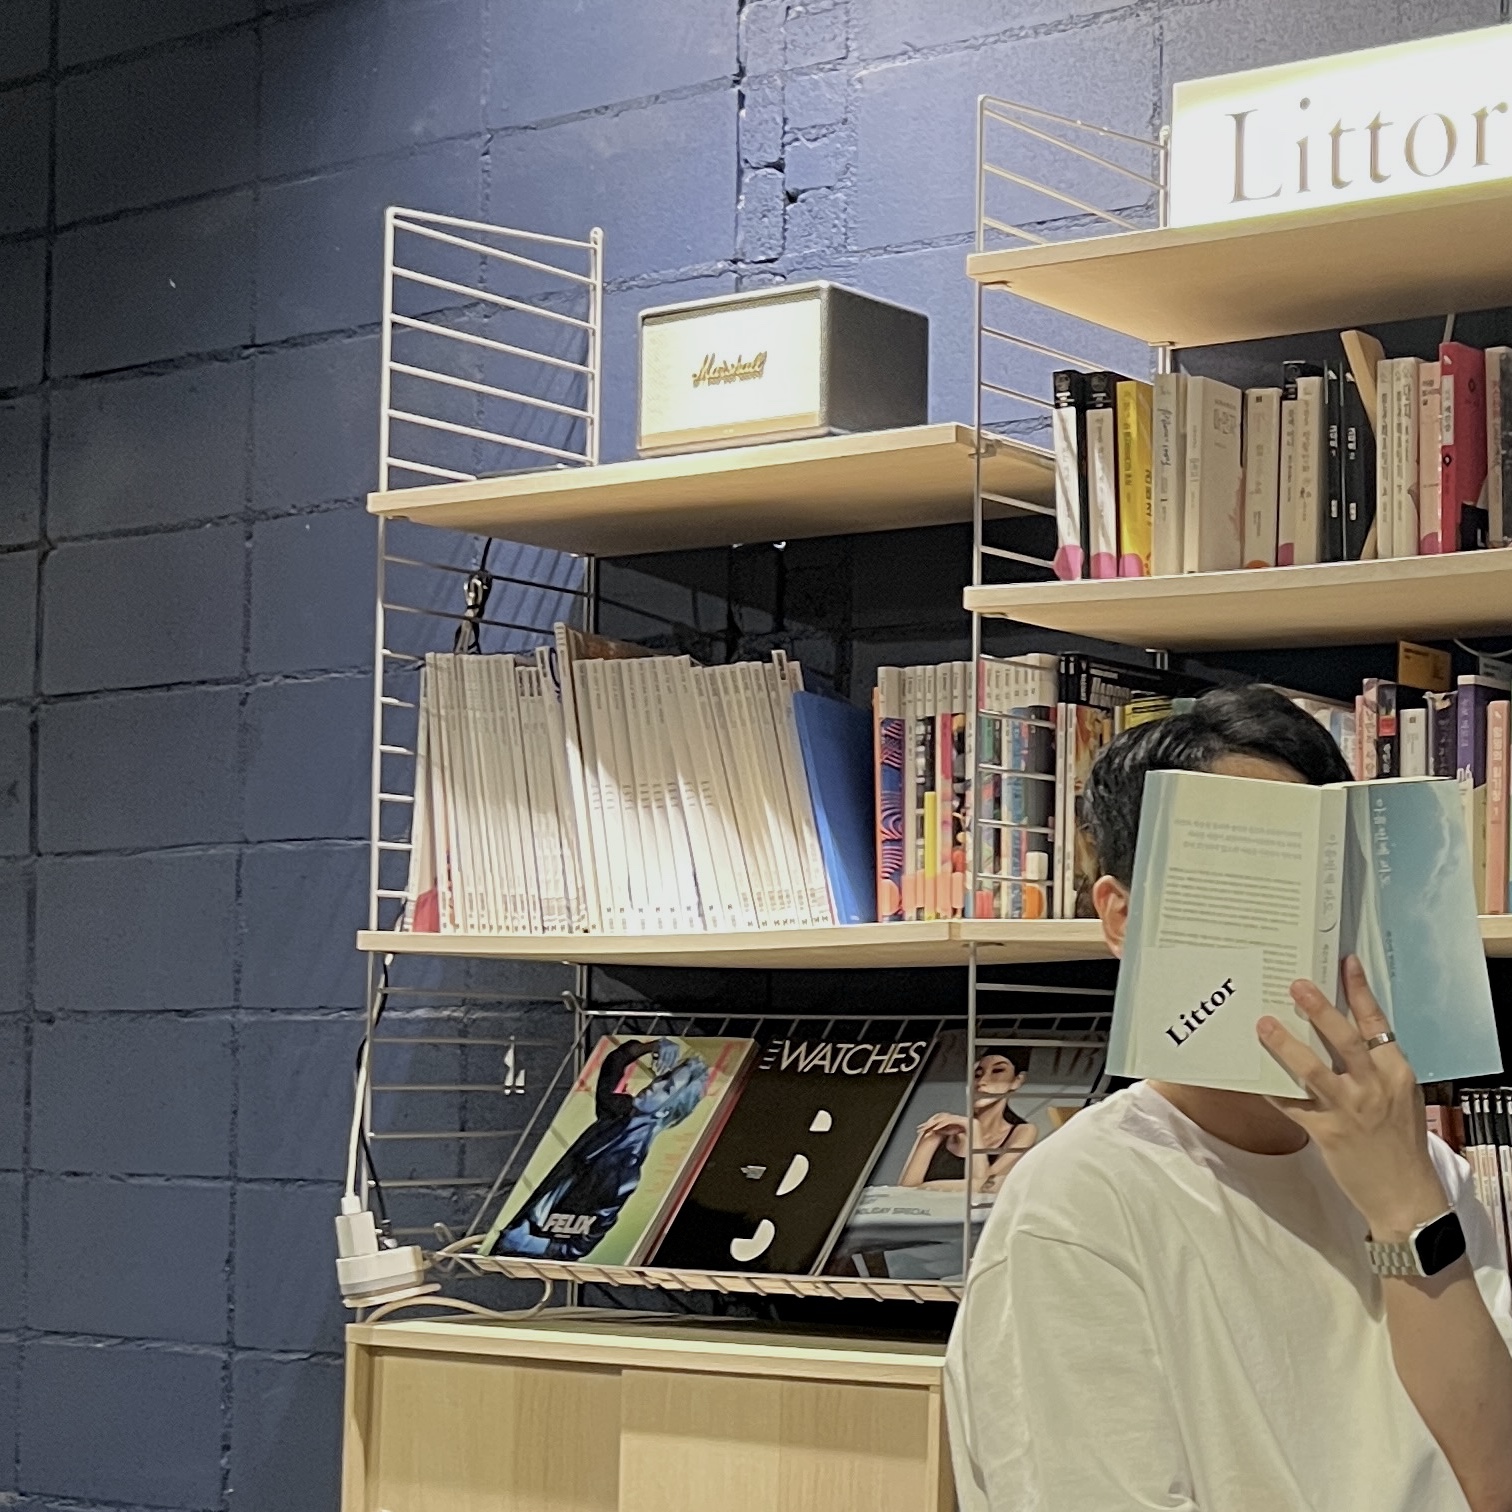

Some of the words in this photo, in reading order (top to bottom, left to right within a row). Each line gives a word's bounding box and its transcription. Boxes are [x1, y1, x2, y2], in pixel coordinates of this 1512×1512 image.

[1225, 97, 1508, 203] Littor
[692, 351, 767, 387] Marshall
[1165, 978, 1237, 1048] Littor
[780, 1039, 927, 1075] WATCHES
[541, 1213, 598, 1235] FELIX
